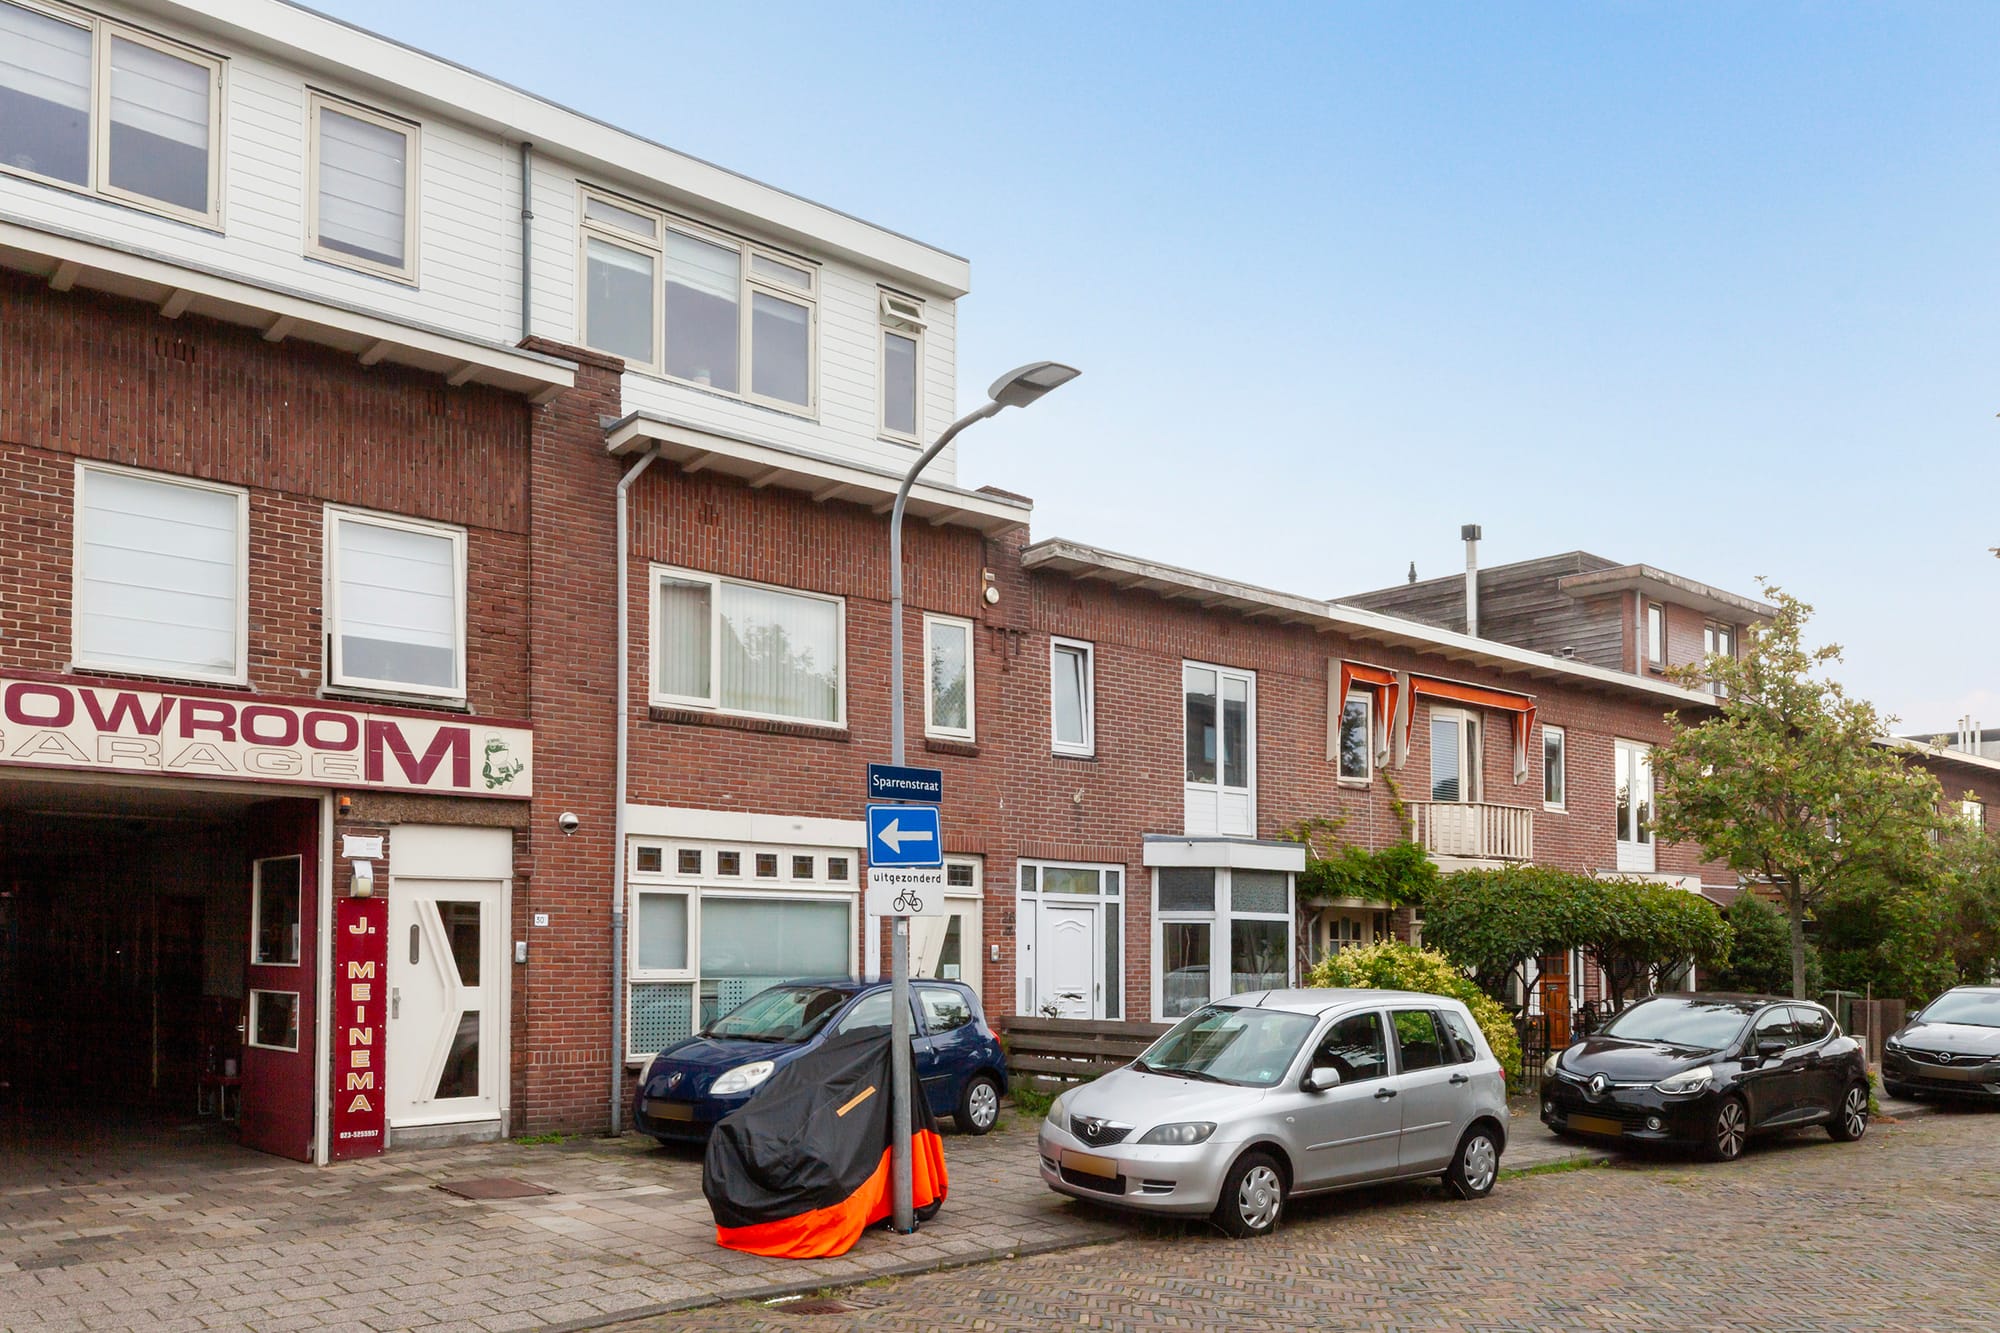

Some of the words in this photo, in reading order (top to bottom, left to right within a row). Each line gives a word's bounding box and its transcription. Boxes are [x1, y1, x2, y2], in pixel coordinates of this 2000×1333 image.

[0, 729, 359, 780] ARAGE
[873, 775, 939, 791] Sparrenstraat
[874, 873, 941, 885] uitgezonderd
[349, 917, 376, 935] J.
[347, 961, 375, 1113] MEINEMA
